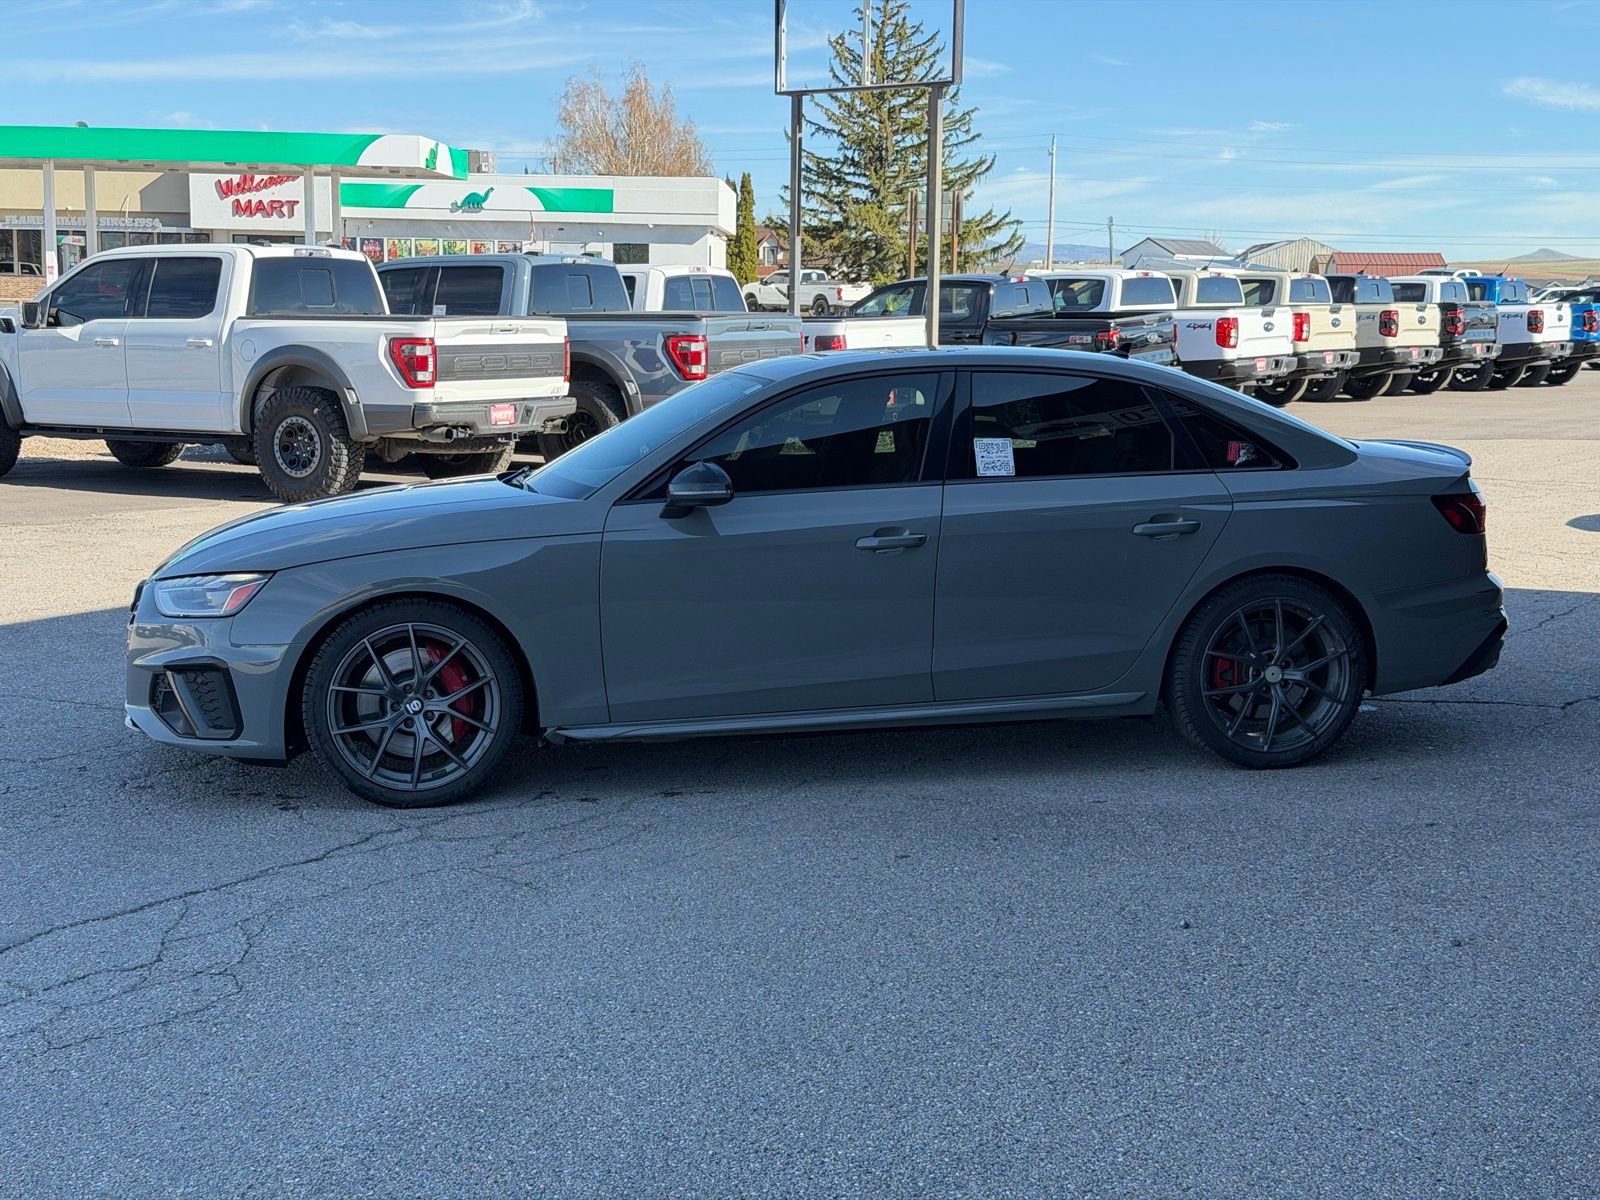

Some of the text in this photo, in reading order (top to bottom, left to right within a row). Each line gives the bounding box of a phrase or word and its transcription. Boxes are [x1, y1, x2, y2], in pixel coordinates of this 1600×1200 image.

[232, 199, 299, 218] MART
[100, 217, 133, 227] SINCE
[134, 218, 161, 228] 1954
[454, 353, 554, 371] FORD
